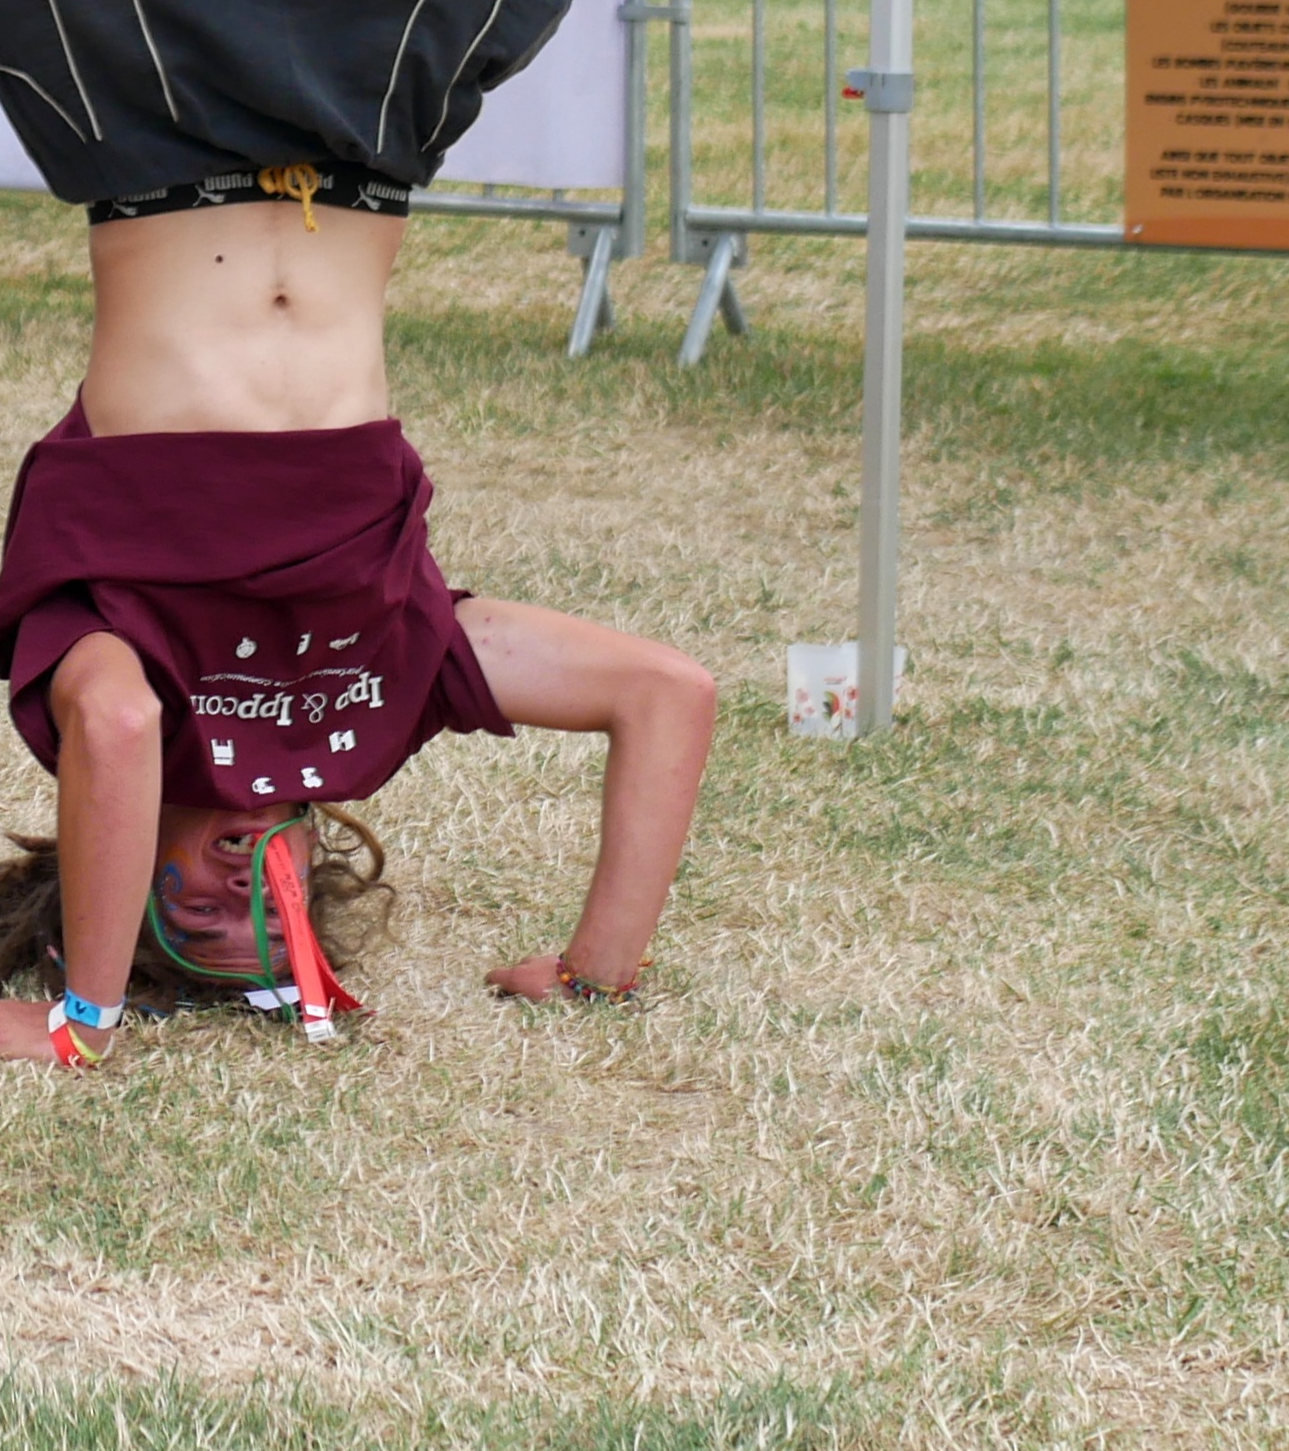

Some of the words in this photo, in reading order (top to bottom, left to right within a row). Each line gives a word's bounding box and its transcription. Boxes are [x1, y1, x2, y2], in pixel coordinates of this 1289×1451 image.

[204, 172, 254, 192] PUMA
[334, 670, 385, 712] Ipp
[300, 692, 329, 724] &
